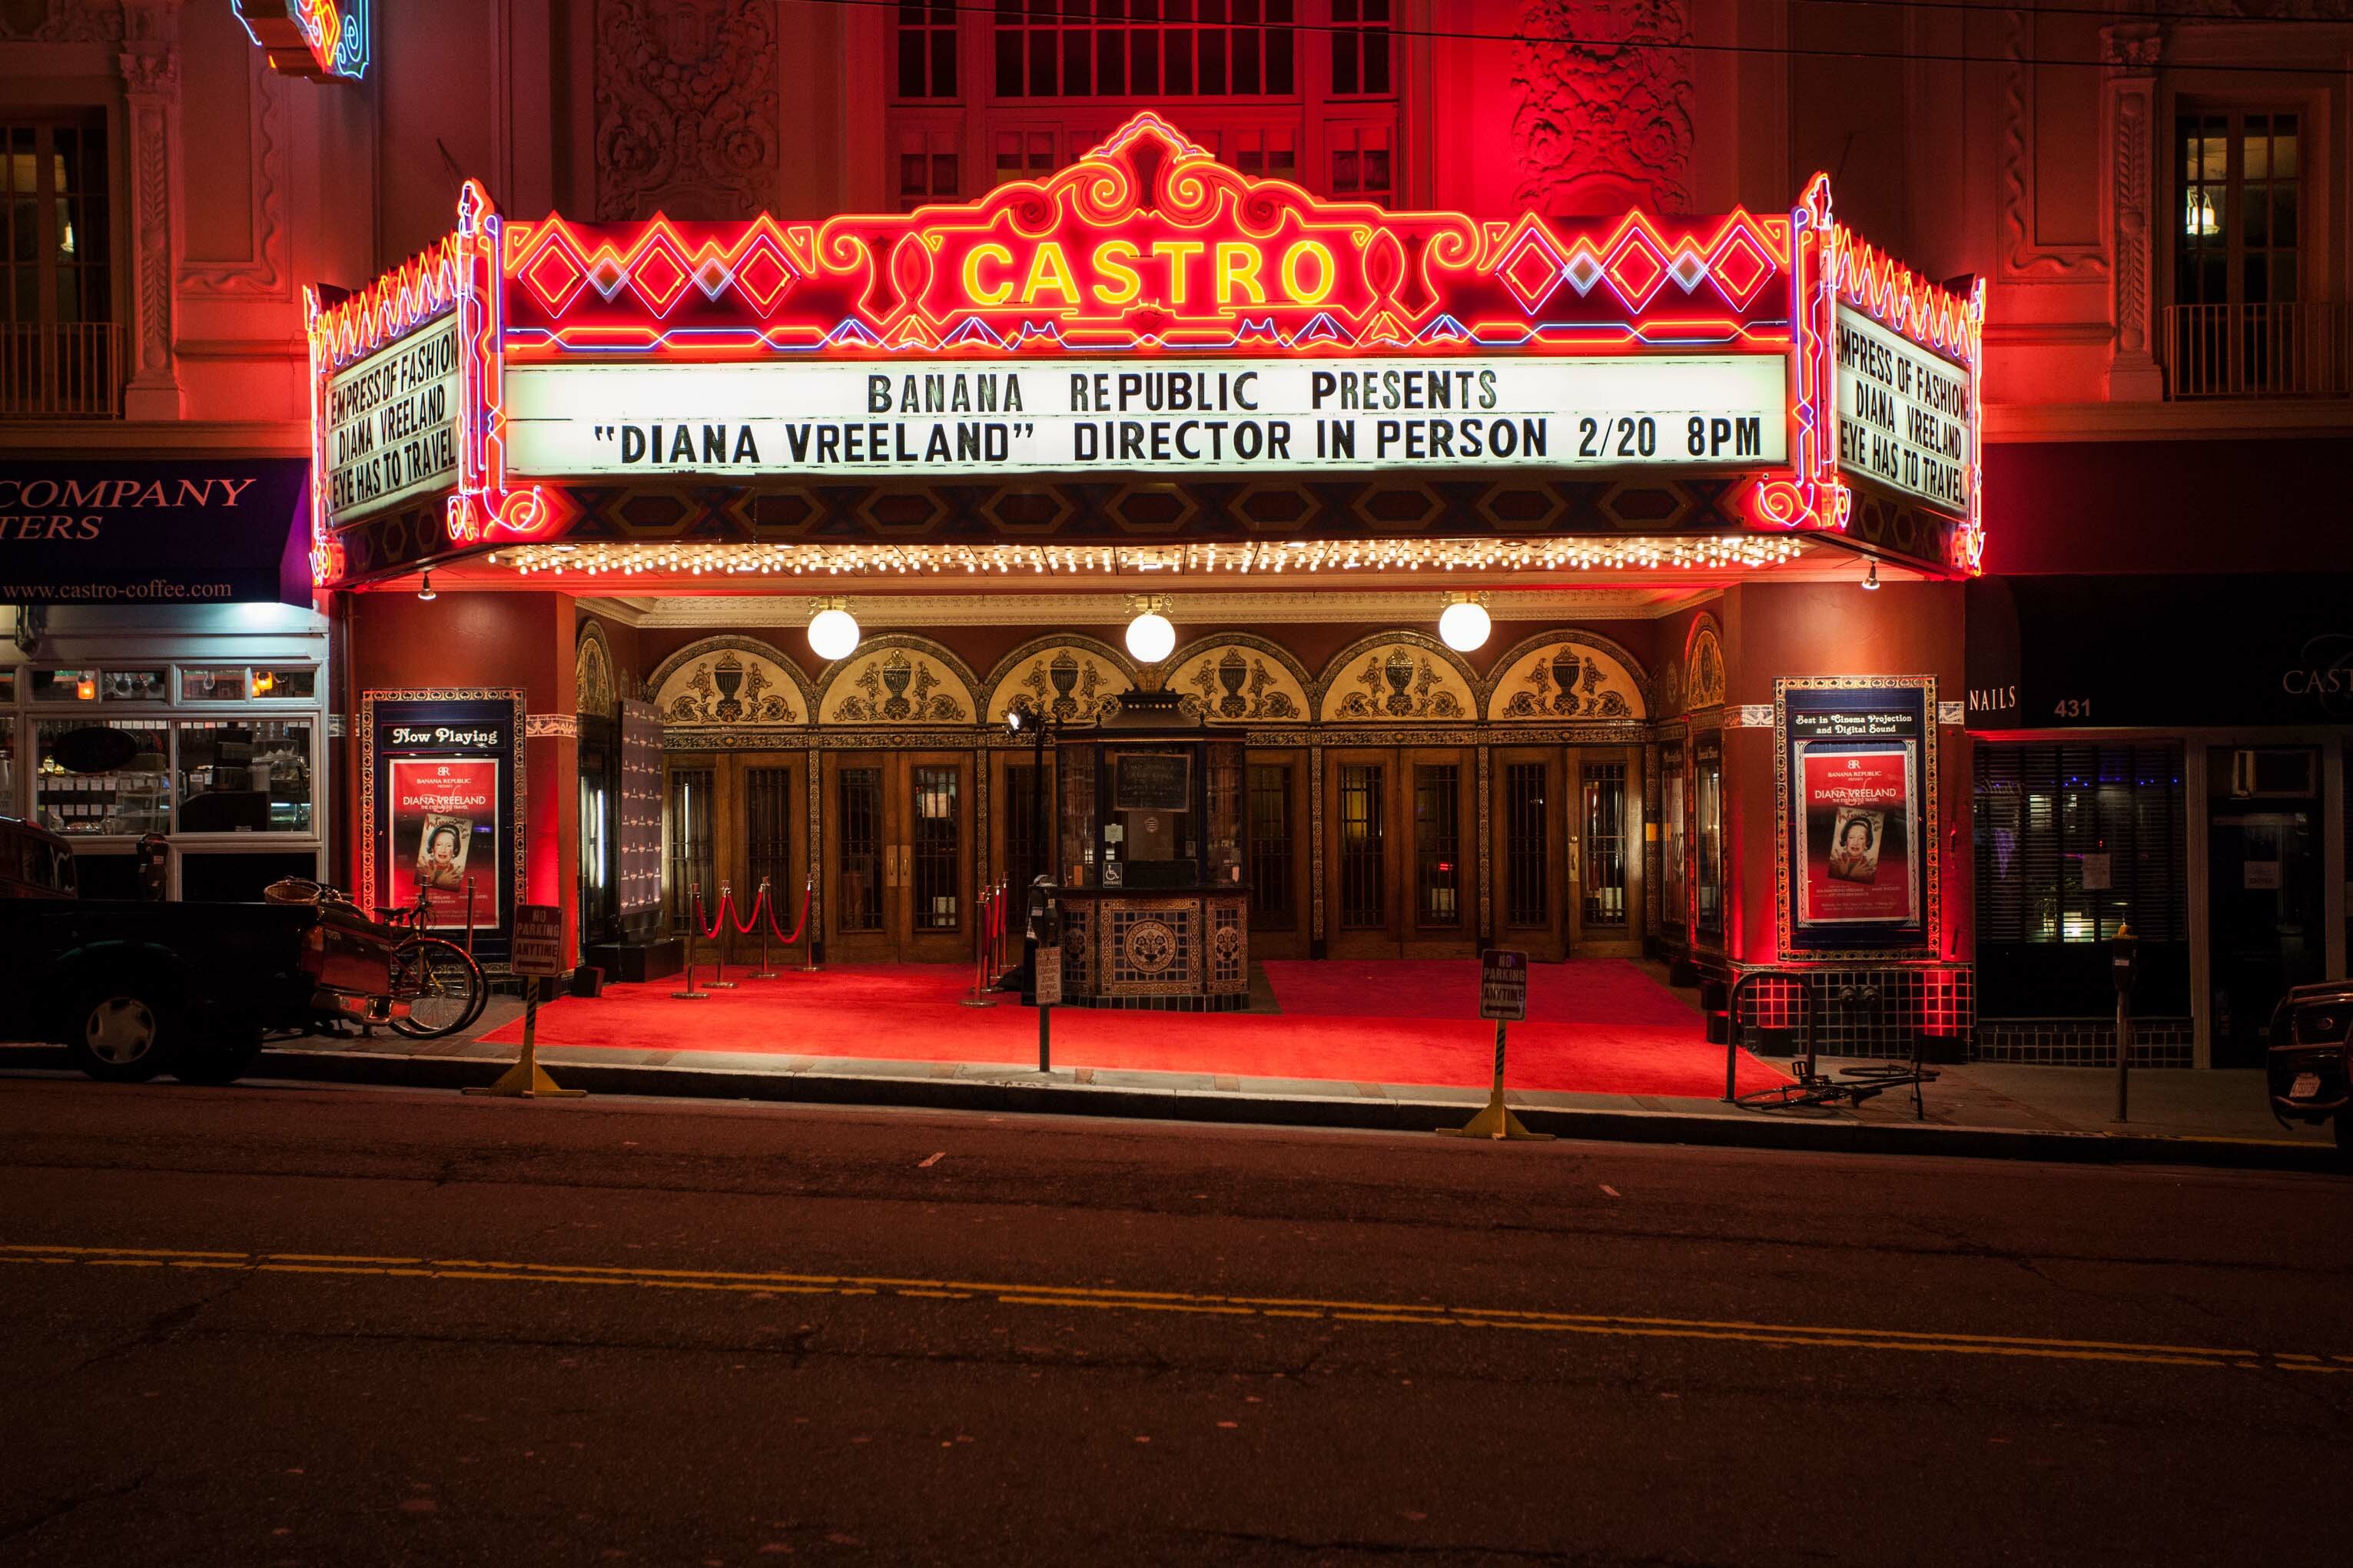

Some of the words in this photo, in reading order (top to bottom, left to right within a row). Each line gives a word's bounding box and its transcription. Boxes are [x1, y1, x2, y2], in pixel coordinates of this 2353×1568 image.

[963, 240, 1334, 305] CASTRO
[1897, 356, 1912, 395] OF
[331, 369, 380, 425] EMPRESS
[382, 361, 397, 401] OF
[869, 373, 1023, 413] BANANA
[1071, 372, 1259, 413] REPUBLIC
[1313, 370, 1497, 409] PRESENTS
[339, 417, 373, 464] DIANA
[380, 384, 445, 445] VREELAND
[1857, 380, 1895, 433] DIANA
[1907, 405, 1961, 461] VREELAND
[1075, 420, 1290, 461] DIRECTOR
[1318, 419, 1355, 460] IN
[1377, 419, 1547, 459] PERSON
[1579, 416, 1655, 458] 2/20
[1688, 416, 1761, 456] 8PM
[333, 468, 353, 509] EYE
[357, 459, 380, 500] HAS
[383, 449, 401, 489] TO
[404, 428, 456, 482] TRAVEL
[1841, 420, 1866, 464] EYE
[1873, 433, 1898, 479] HAS
[1904, 449, 1918, 486] TO
[1923, 457, 1965, 506] TRAVEL
[3, 579, 232, 598] www.castro-coffee.com
[1970, 685, 2016, 711] NAILS
[2054, 698, 2090, 718] 431
[1795, 714, 1817, 725] Best
[1831, 714, 1865, 724] Cinema
[1868, 714, 1912, 724] Projection
[1817, 726, 1832, 734] and
[1835, 724, 1867, 734] Digital
[1870, 724, 1896, 734] Sound
[393, 728, 431, 744] Now
[435, 728, 498, 745] Playing
[403, 796, 435, 805] DIANA
[437, 795, 486, 805] VREELAND
[1814, 790, 1847, 798] DIANA
[1849, 788, 1897, 797] VREELAND
[532, 910, 546, 923] NO
[516, 923, 559, 937] PARKING
[516, 943, 557, 956] ANYTIME
[1498, 954, 1512, 967] NO
[1484, 968, 1525, 982] PARKING
[1484, 986, 1524, 1002] ANYTIME
